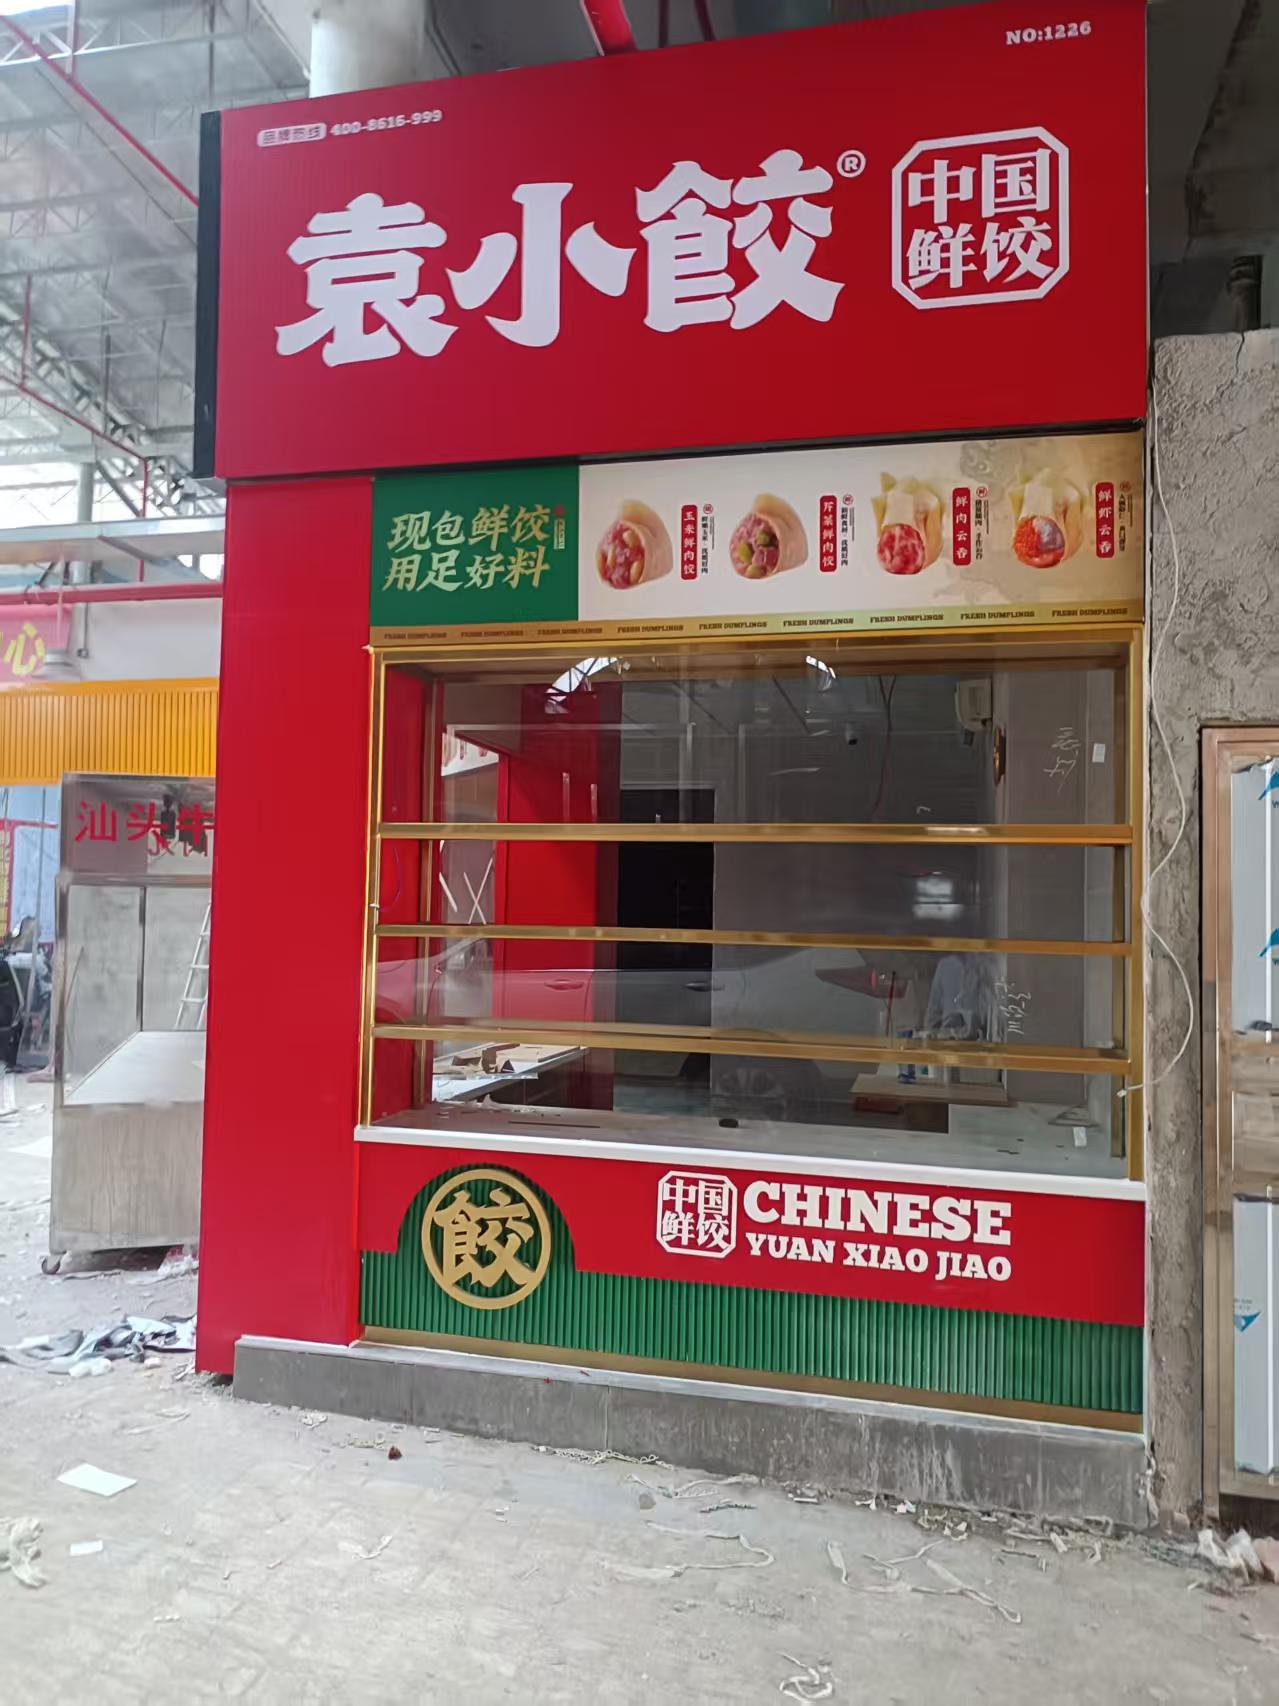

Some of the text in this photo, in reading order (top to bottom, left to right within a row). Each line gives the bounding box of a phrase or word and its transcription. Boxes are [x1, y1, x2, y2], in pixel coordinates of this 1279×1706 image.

[1006, 21, 1092, 45] NO:1226
[907, 147, 1053, 224] 中国
[906, 215, 1053, 289] 鲜饺
[386, 504, 551, 552] 现包鲜饺
[382, 545, 551, 592] 用足好料
[0, 623, 46, 676] 心
[662, 1178, 729, 1217] 中国
[743, 1181, 1012, 1246] CHINESE
[661, 1209, 730, 1251] 鲜饺
[745, 1232, 1012, 1281] YUAN XIAO JIAO
